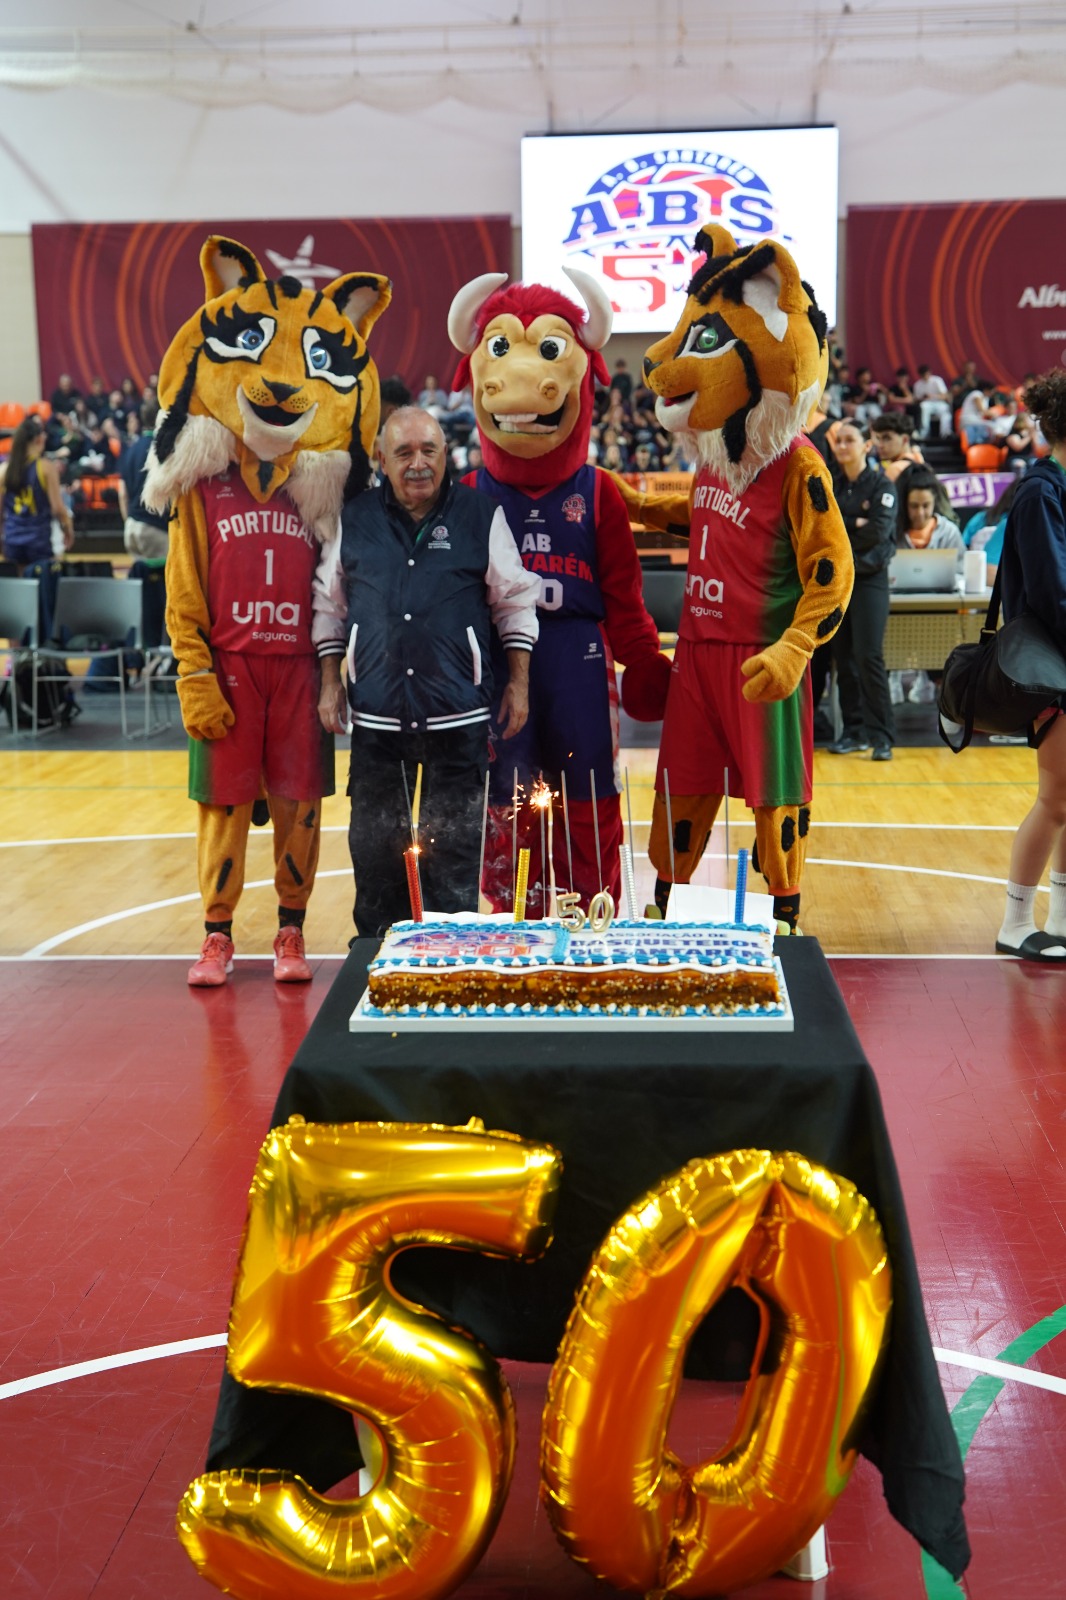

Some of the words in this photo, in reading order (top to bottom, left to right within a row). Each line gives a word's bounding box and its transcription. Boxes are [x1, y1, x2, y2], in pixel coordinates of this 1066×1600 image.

[693, 485, 751, 530] ORTUGAL
[521, 533, 552, 553] AB
[700, 525, 709, 561] 1
[264, 549, 274, 585] 1
[232, 601, 300, 626] una
[690, 605, 723, 619] eguros
[252, 631, 297, 642] seguros
[556, 886, 616, 933] 50
